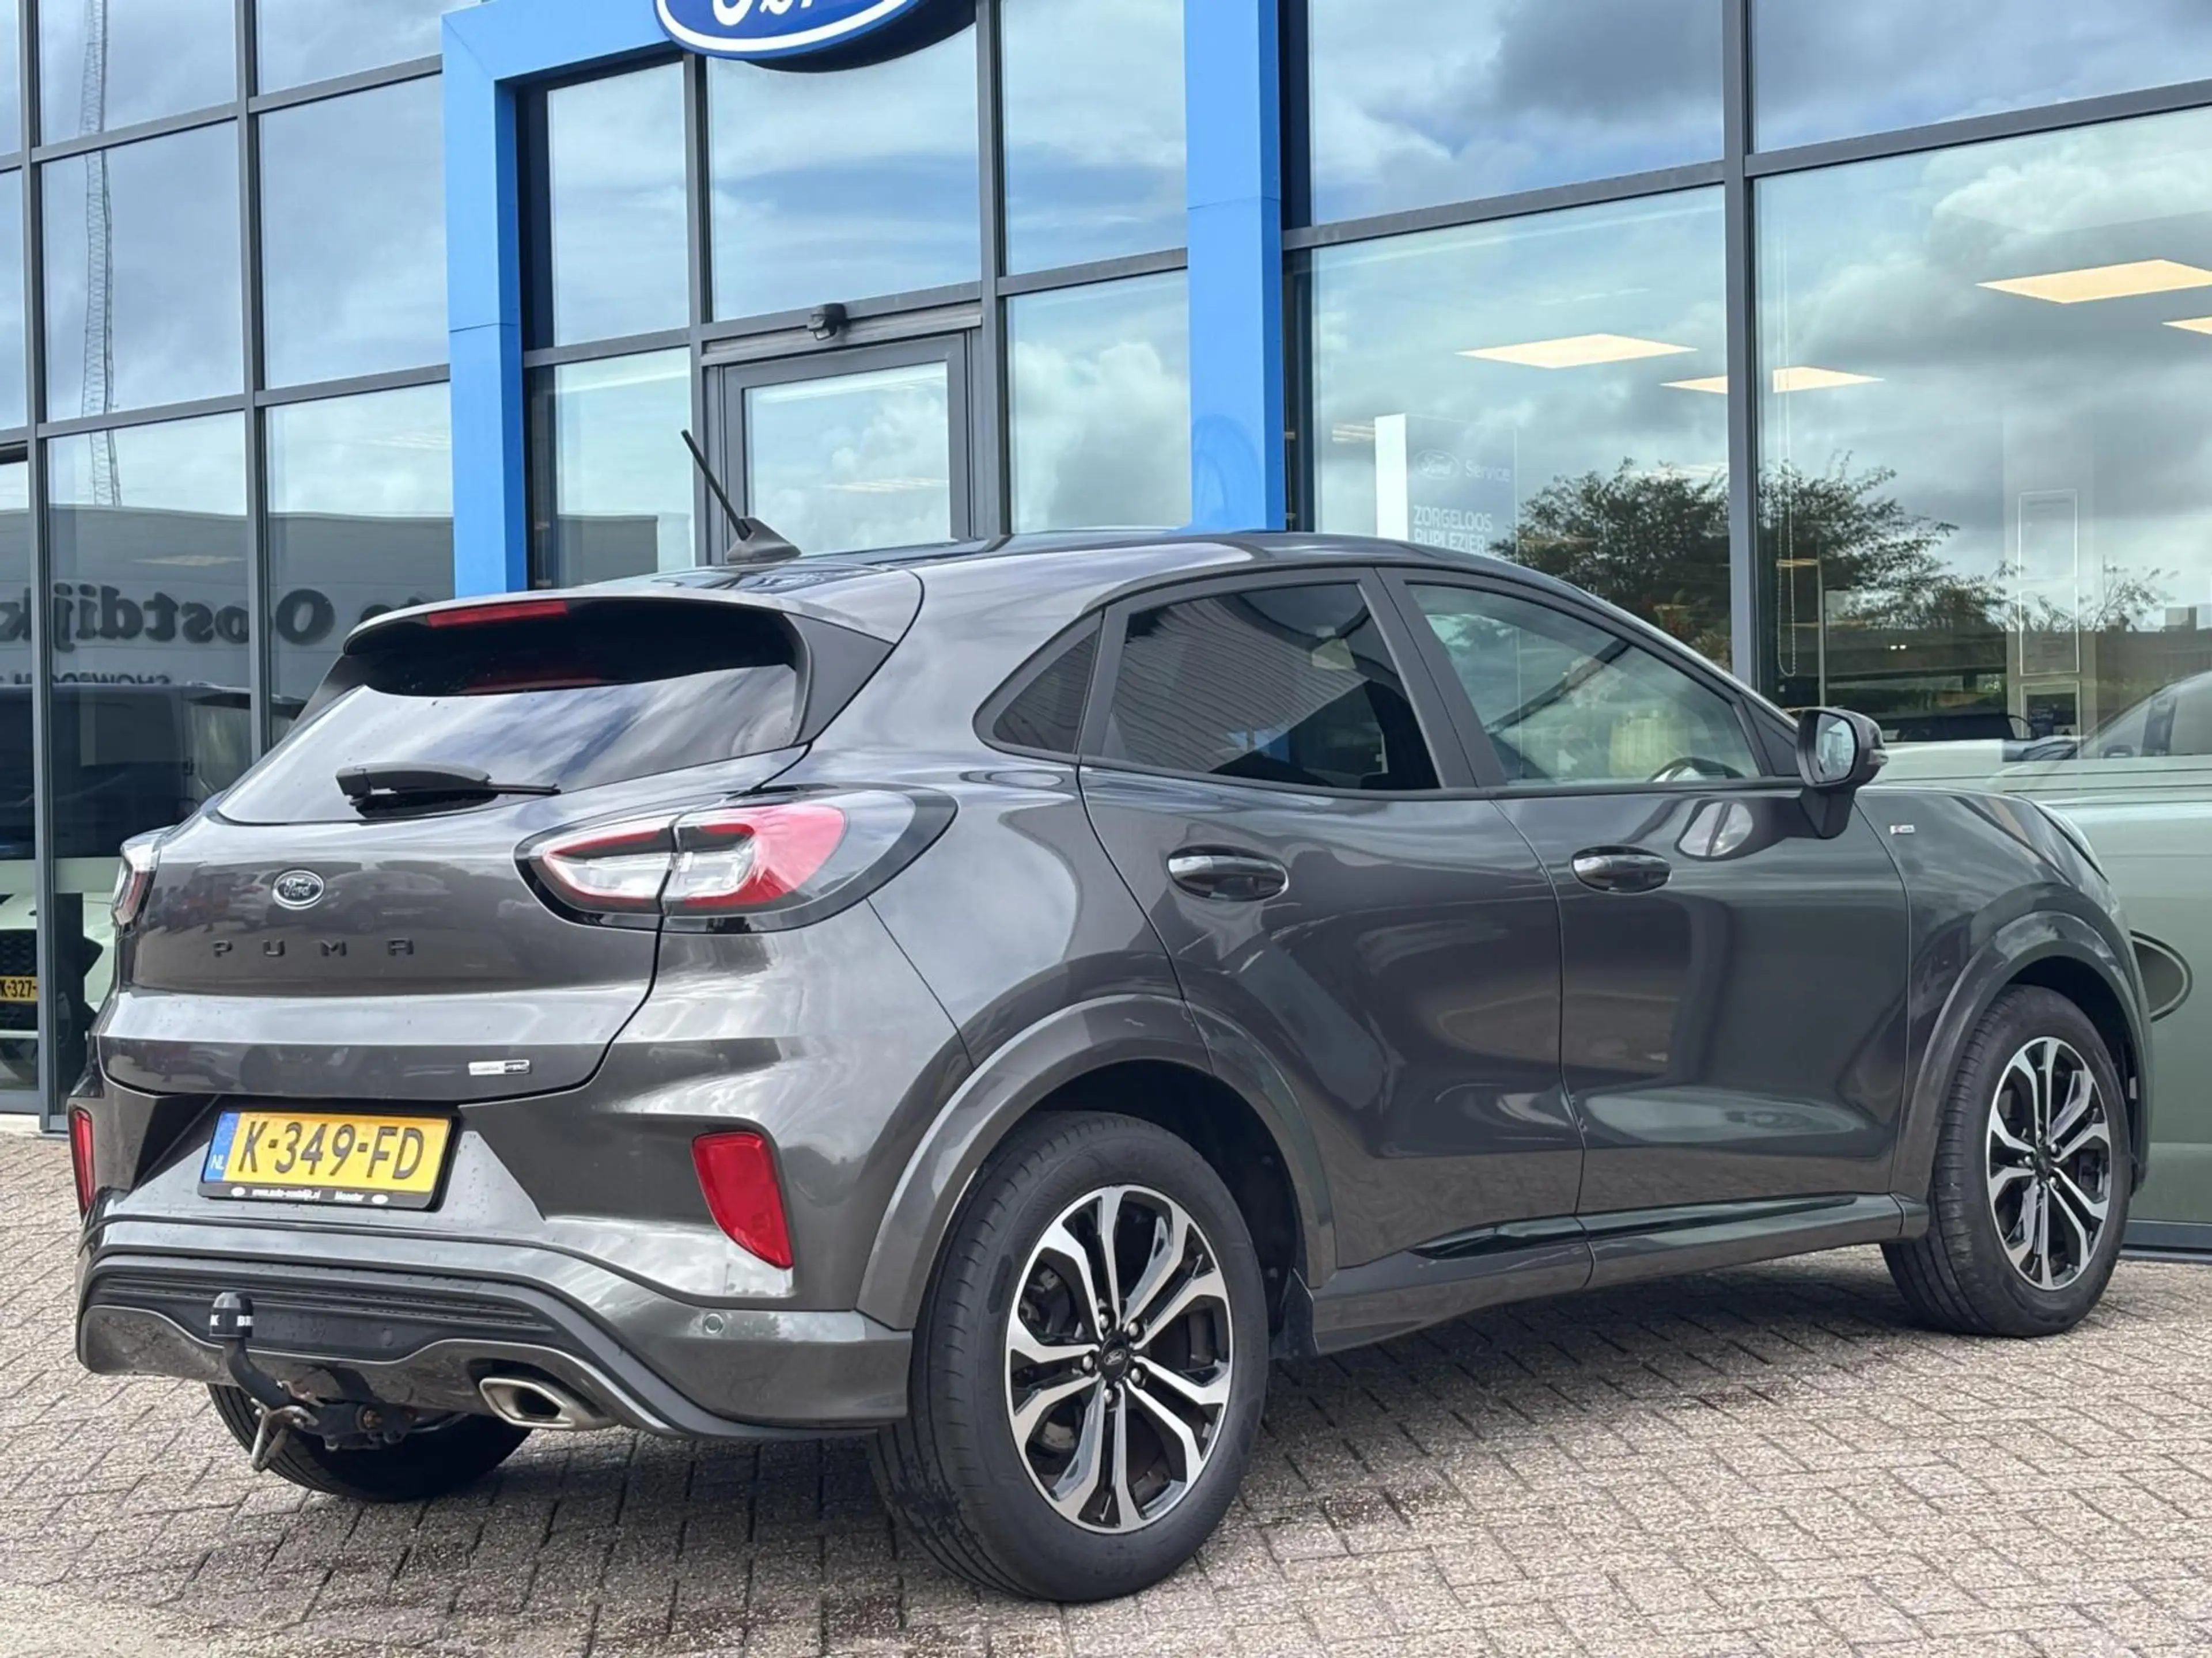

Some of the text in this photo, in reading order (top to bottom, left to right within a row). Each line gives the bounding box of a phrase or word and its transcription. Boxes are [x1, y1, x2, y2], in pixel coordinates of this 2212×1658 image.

[1465, 459, 1510, 483] Service
[1413, 504, 1493, 533] ZORGELOOS
[213, 939, 414, 957] PUMA
[210, 1154, 224, 1170] NL
[238, 1120, 425, 1180] K-349-FD
